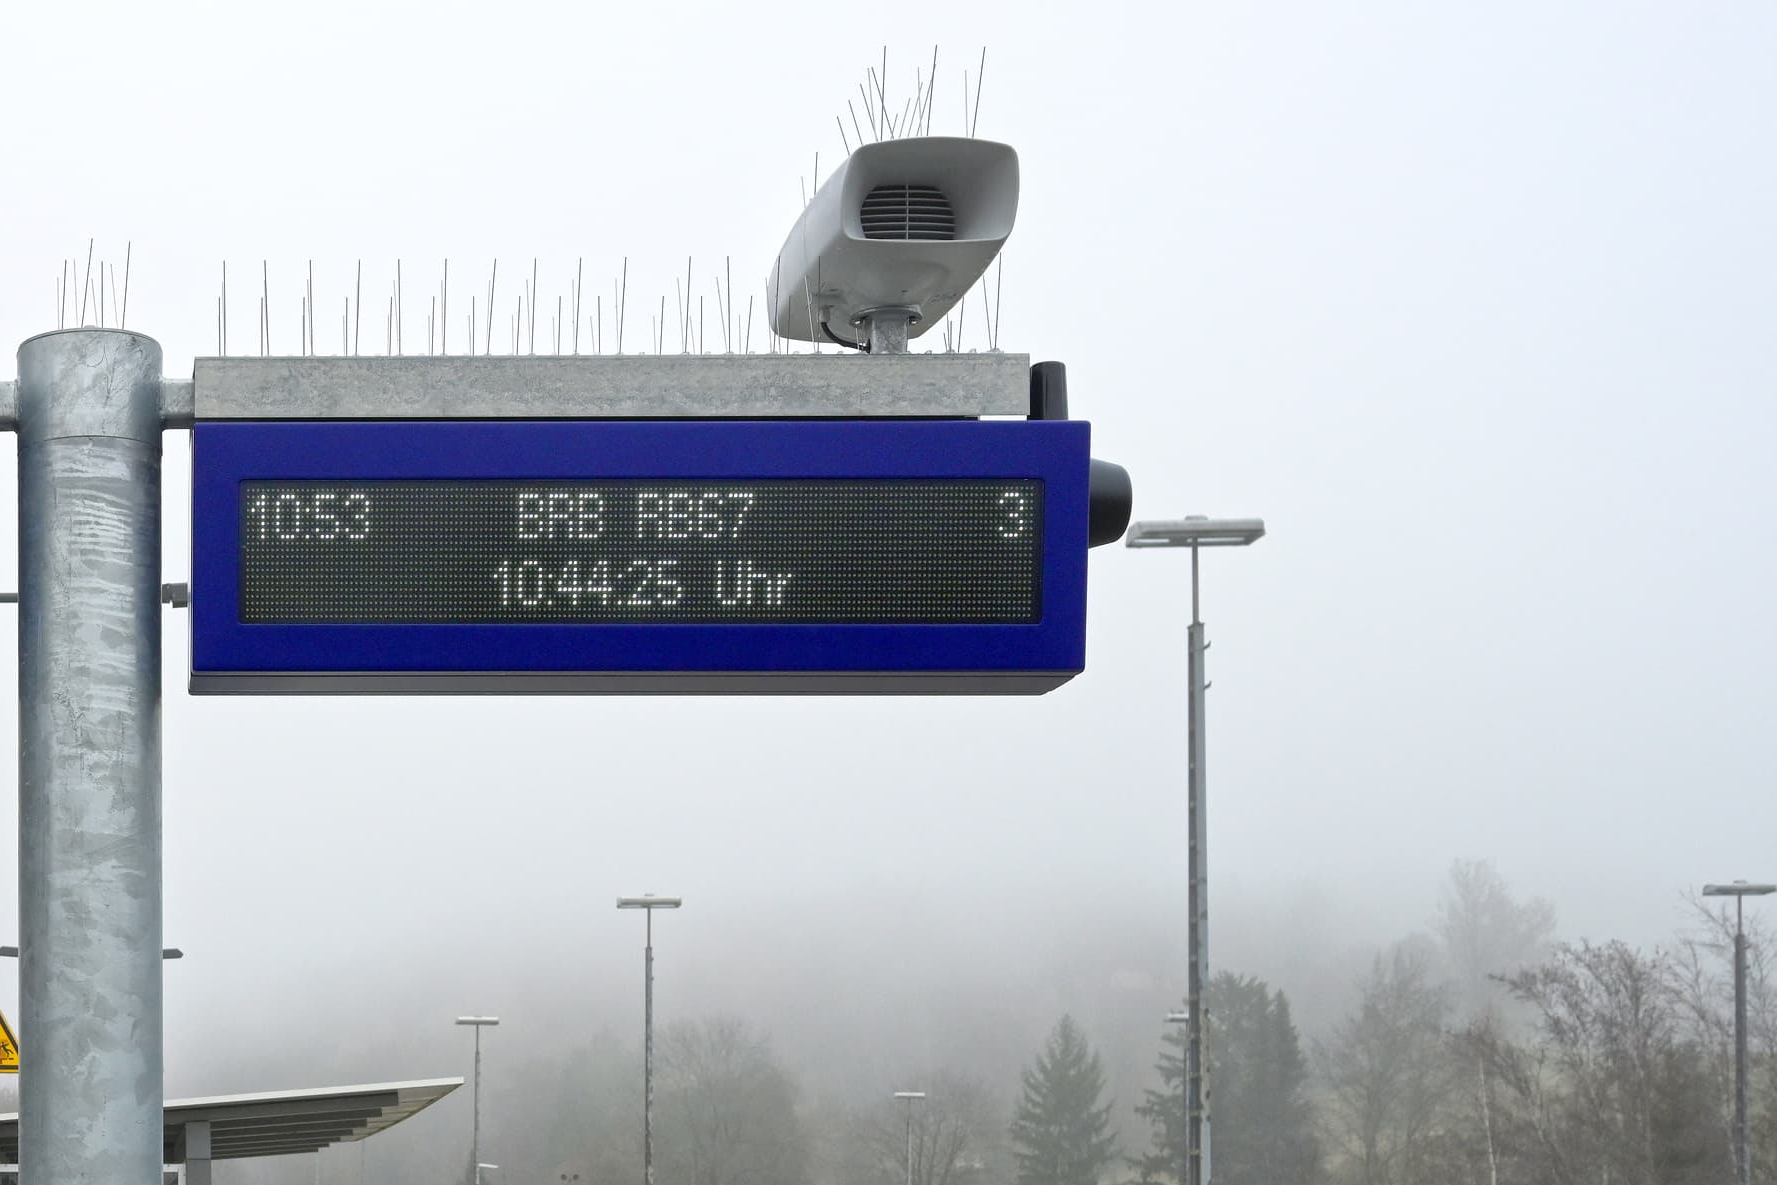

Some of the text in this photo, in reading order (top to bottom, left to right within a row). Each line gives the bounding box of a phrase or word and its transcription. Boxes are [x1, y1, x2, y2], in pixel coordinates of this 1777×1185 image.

[251, 492, 1024, 539] 10:53 BRB RB67 3
[493, 560, 792, 605] 10:44:25 Uhr
